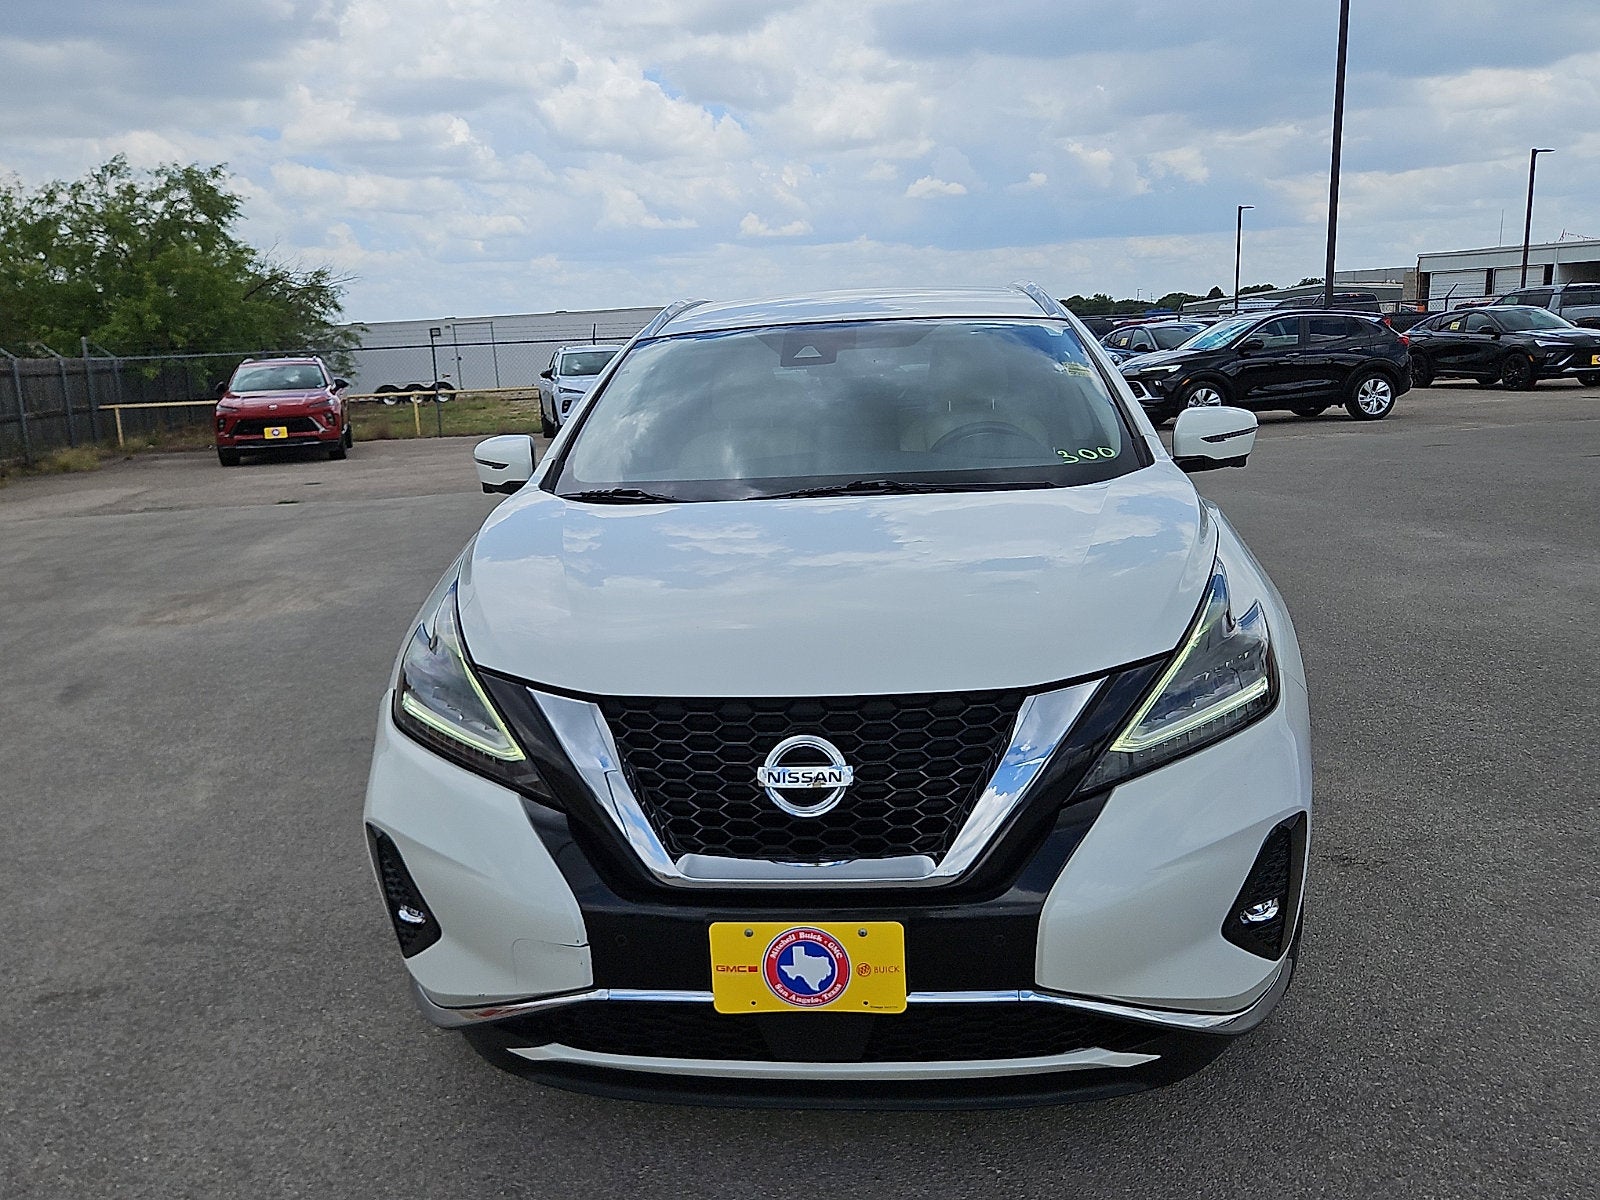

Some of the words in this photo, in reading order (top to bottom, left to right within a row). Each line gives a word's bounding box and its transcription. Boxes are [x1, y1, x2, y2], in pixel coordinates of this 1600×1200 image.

[1057, 446, 1116, 464] 300
[767, 771, 843, 784] NISSAN
[798, 931, 823, 942] Buick
[827, 941, 843, 959] GMC
[715, 964, 747, 973] GMC
[874, 965, 900, 974] BUICK
[774, 983, 789, 997] San
